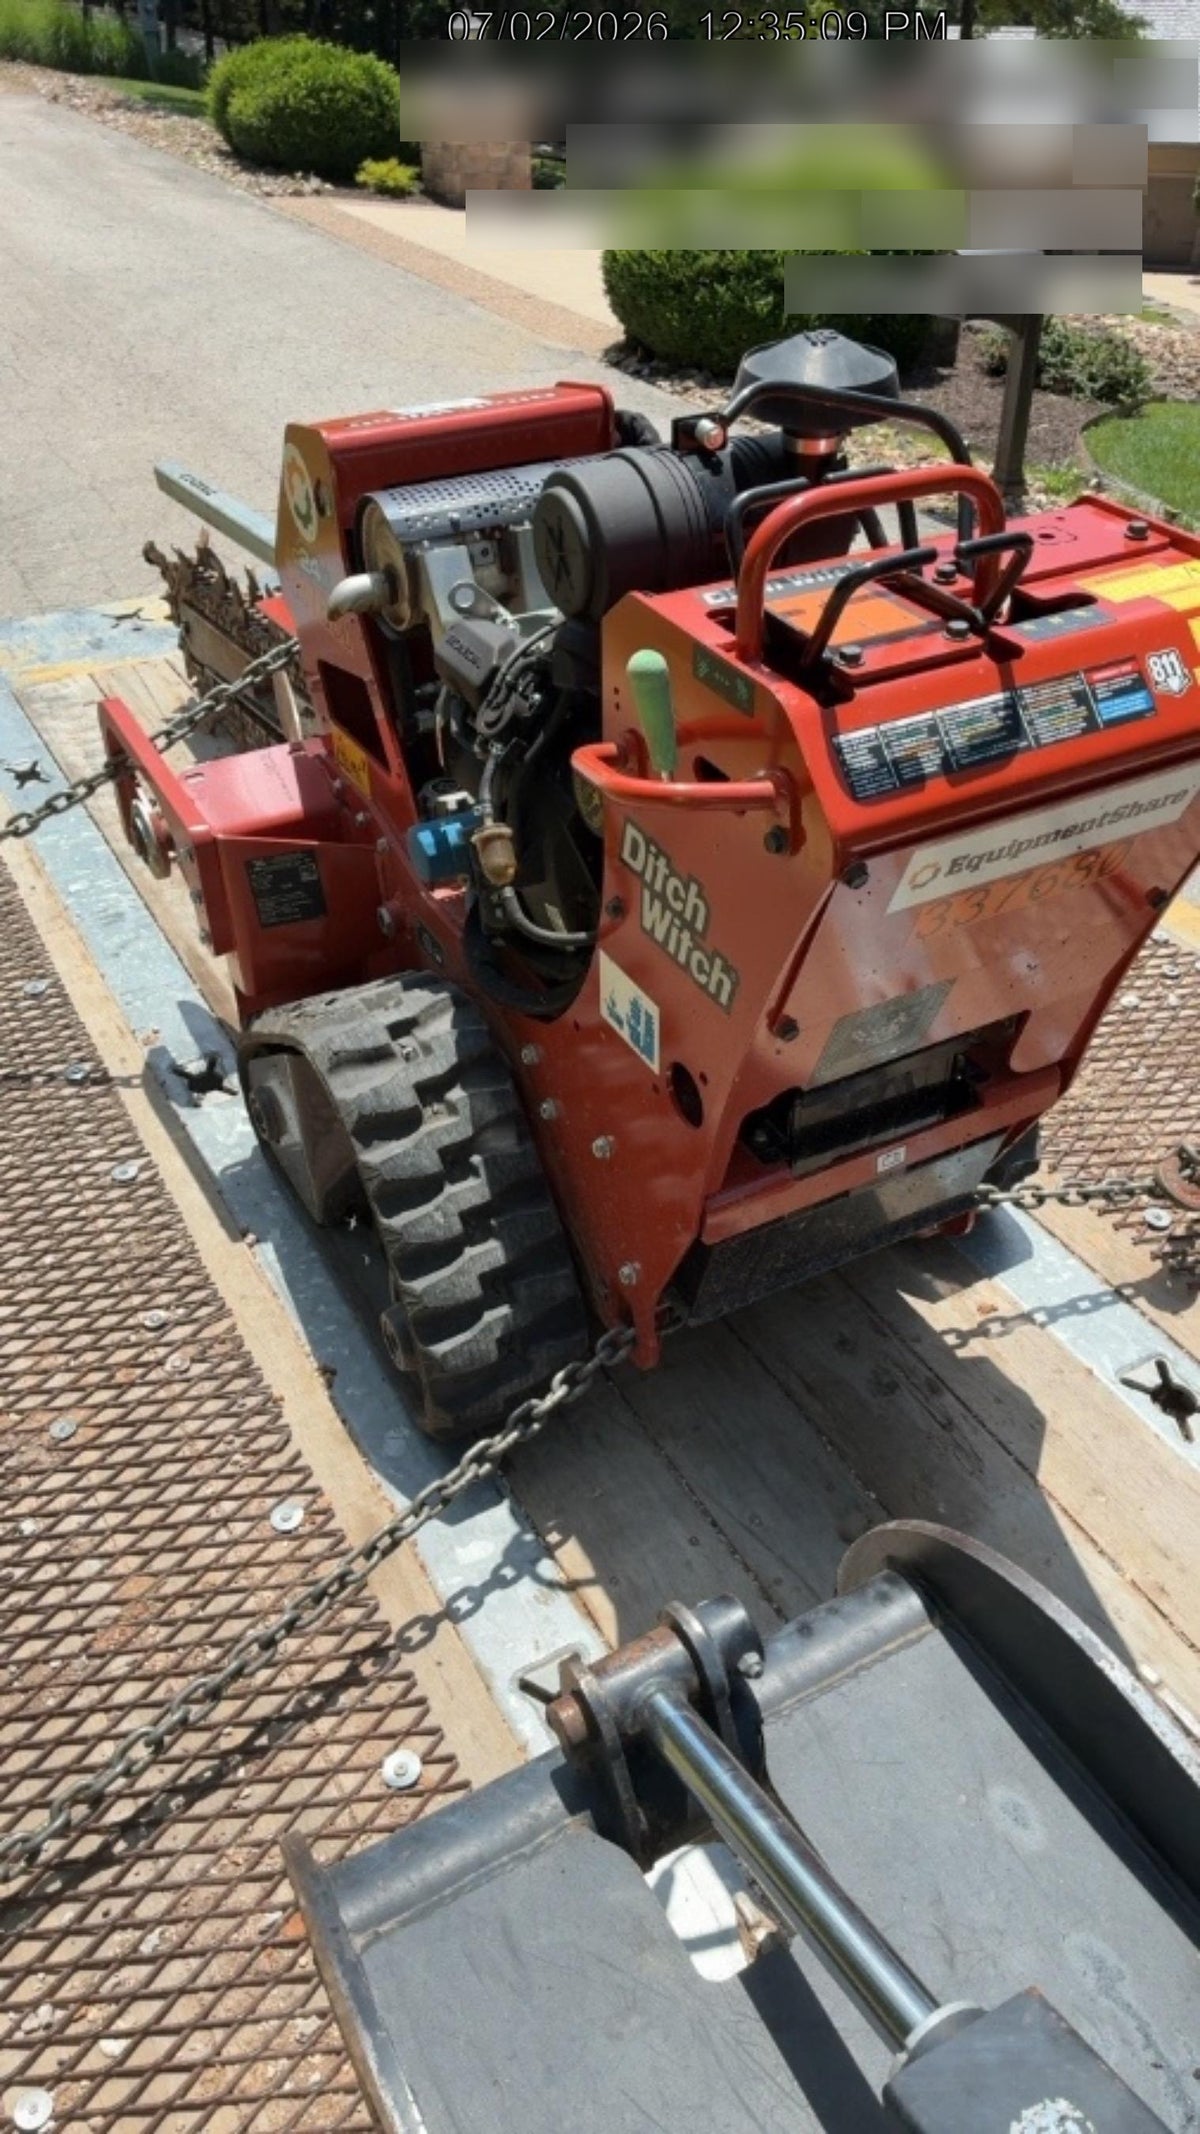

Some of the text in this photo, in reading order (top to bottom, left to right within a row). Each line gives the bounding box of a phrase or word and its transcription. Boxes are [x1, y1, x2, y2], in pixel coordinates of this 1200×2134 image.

[1149, 651, 1182, 684] 811
[621, 821, 708, 935] Ditch
[944, 789, 1188, 877] EquipmentShare
[641, 887, 733, 1007] Witch
